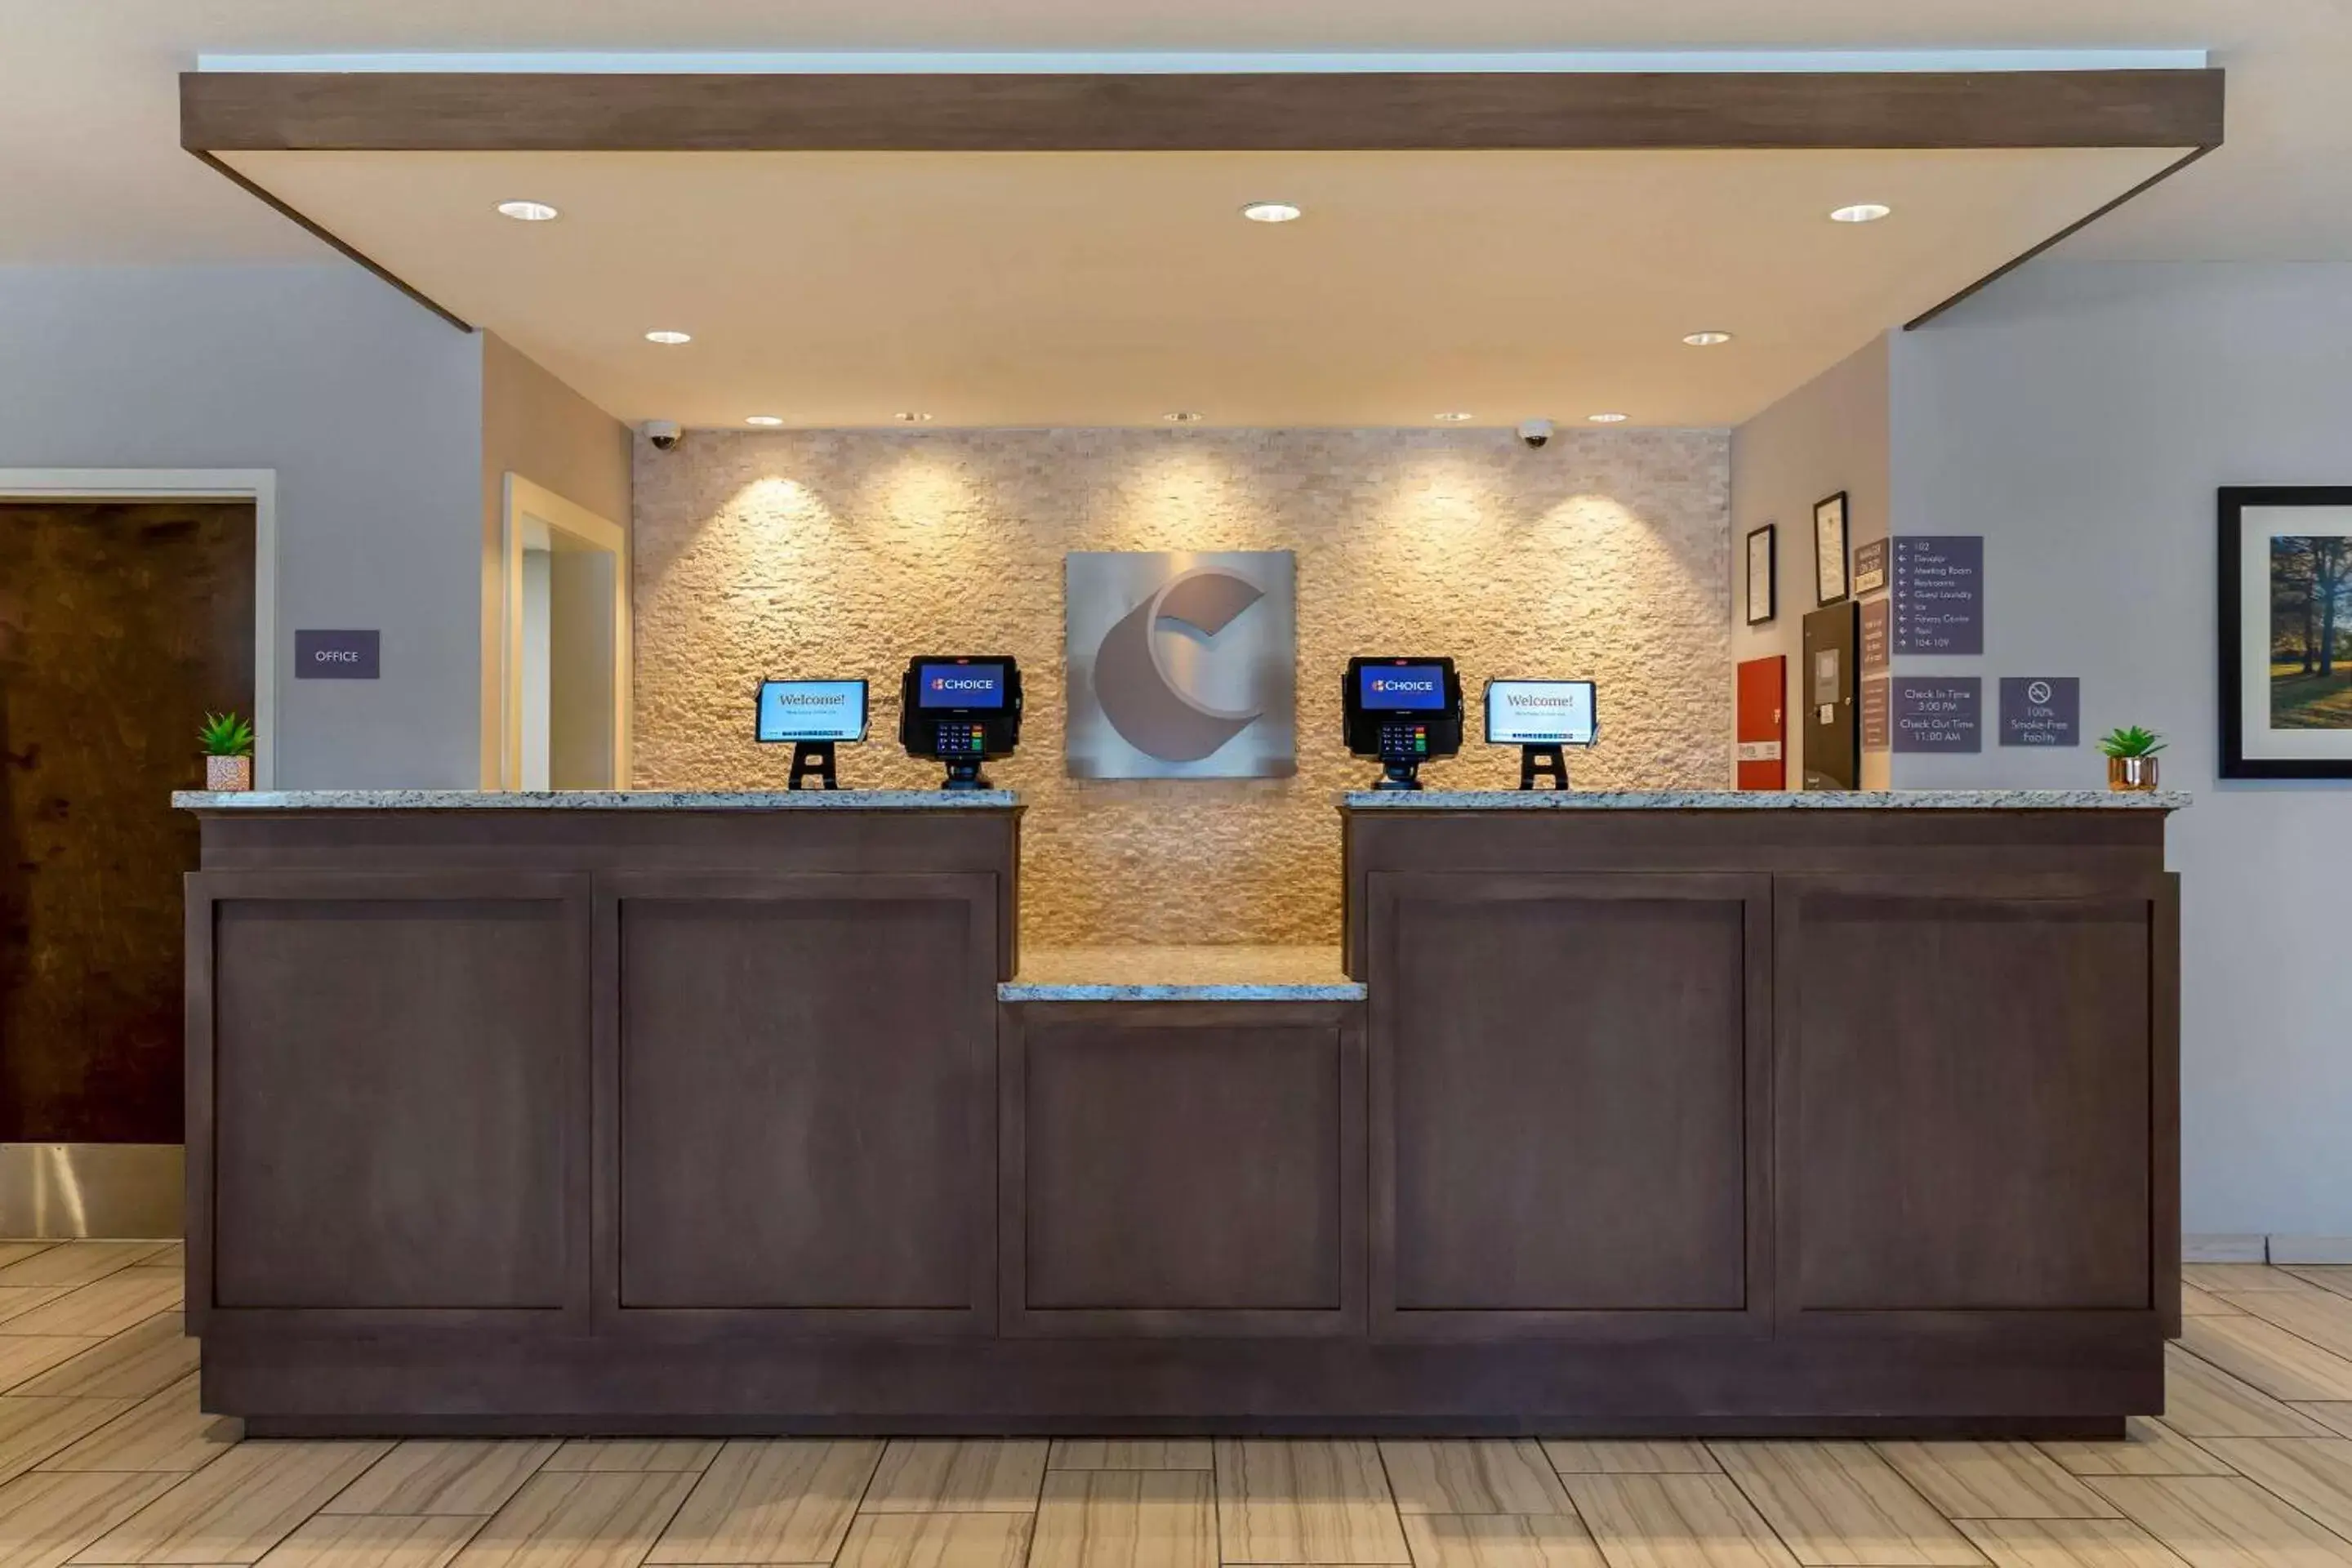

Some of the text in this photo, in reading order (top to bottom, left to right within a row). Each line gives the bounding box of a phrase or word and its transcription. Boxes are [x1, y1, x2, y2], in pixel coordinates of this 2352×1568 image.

[1914, 566, 1971, 577] Meeting Room
[1914, 590, 1971, 600] Guest Laundry
[315, 651, 359, 662] OFFICE
[945, 679, 993, 689] CHOICE
[1385, 680, 1433, 691] CHOICE
[1904, 689, 1971, 698] Check In Time
[780, 694, 844, 706] Welcome!
[1508, 694, 1573, 706] Welcome!
[1918, 702, 1957, 711] 3:00 PM
[1900, 719, 1975, 728] Check Out Time
[1914, 732, 1961, 741] 11:00 AM
